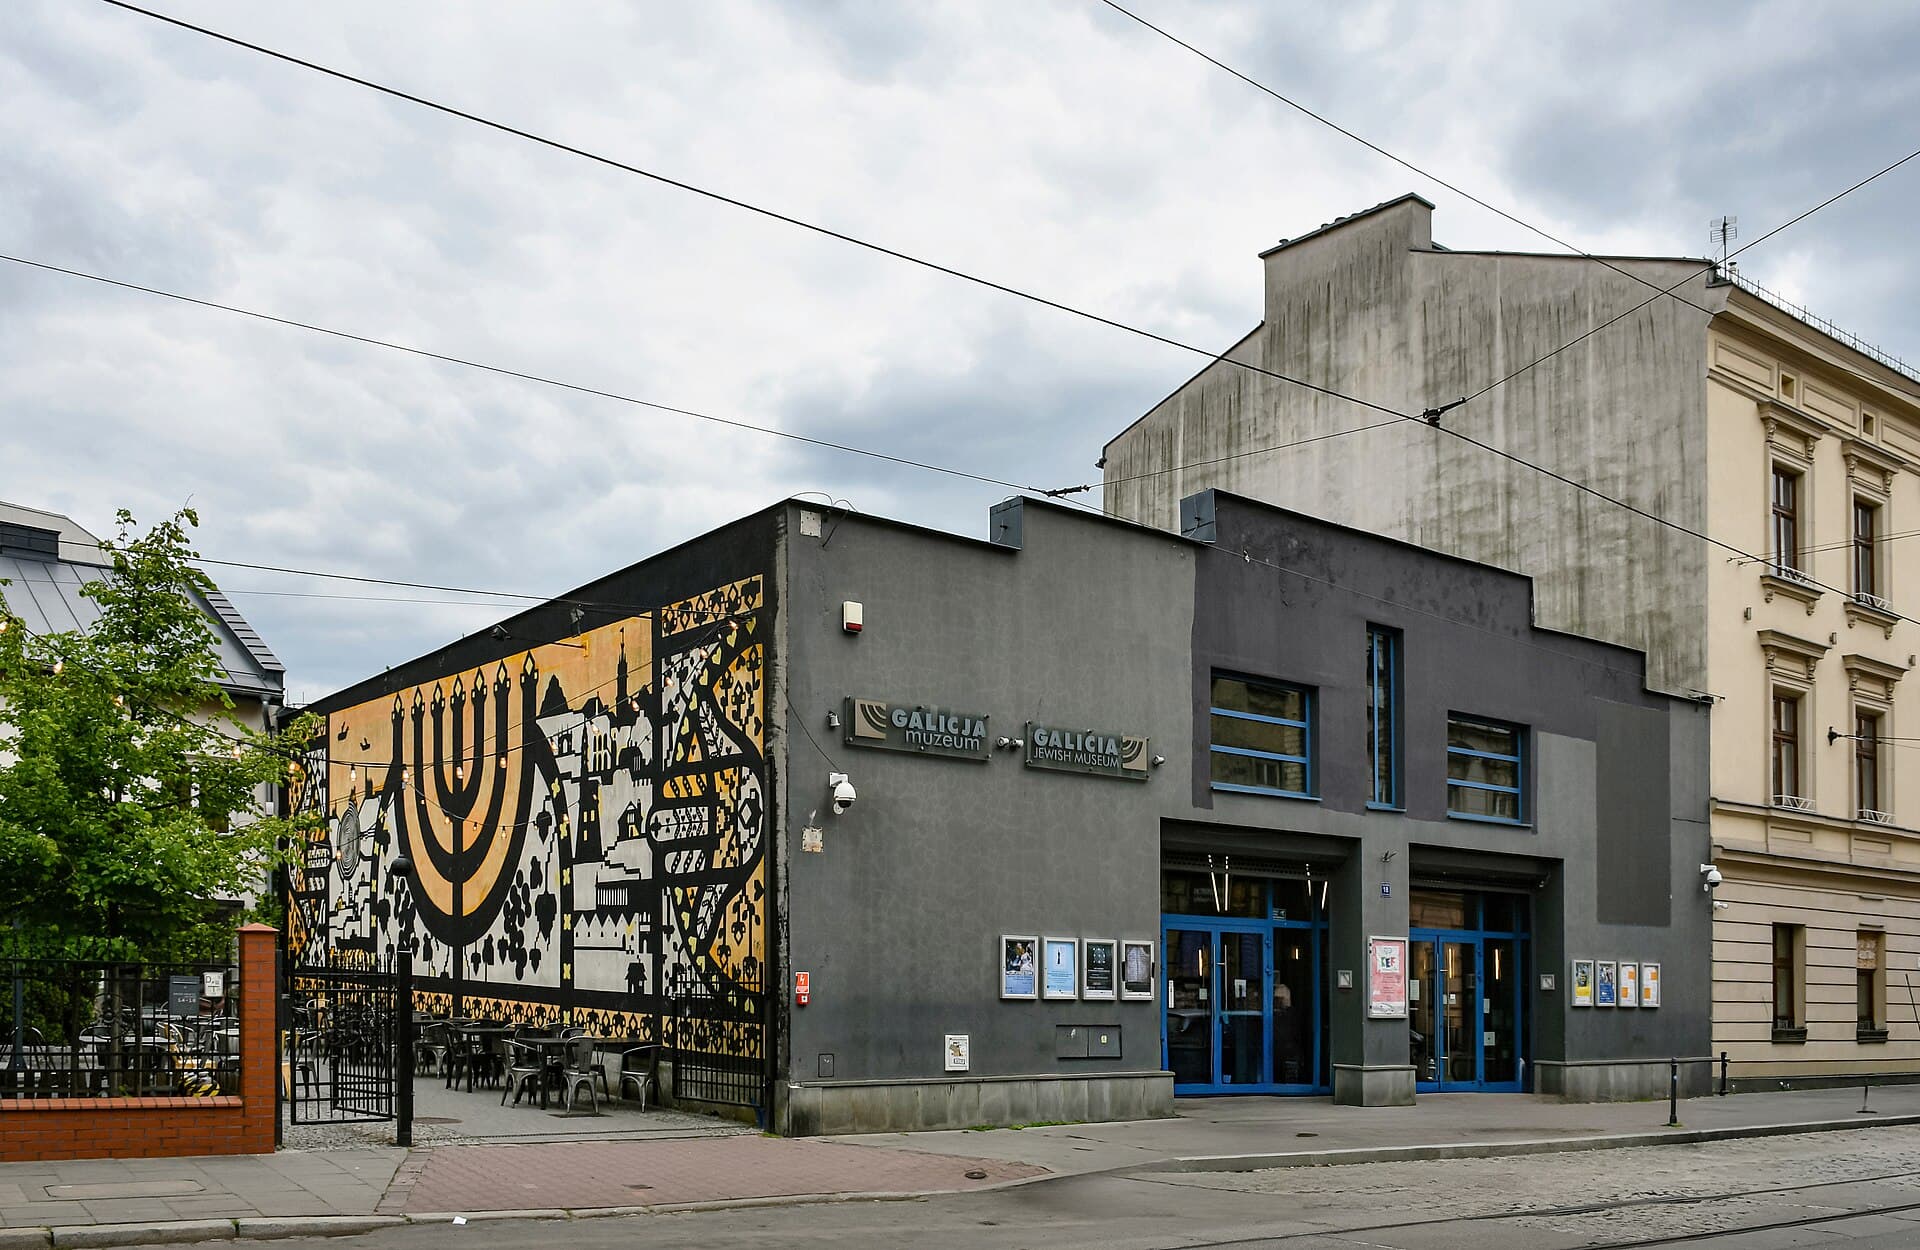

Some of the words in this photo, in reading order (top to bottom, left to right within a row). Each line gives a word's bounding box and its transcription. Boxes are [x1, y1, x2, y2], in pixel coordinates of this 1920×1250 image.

[892, 709, 986, 737] GALICJA
[906, 730, 979, 751] muzeum
[1034, 728, 1118, 756] GALICIA
[1034, 747, 1071, 762] JEWISH
[1074, 753, 1119, 768] MUSEUM
